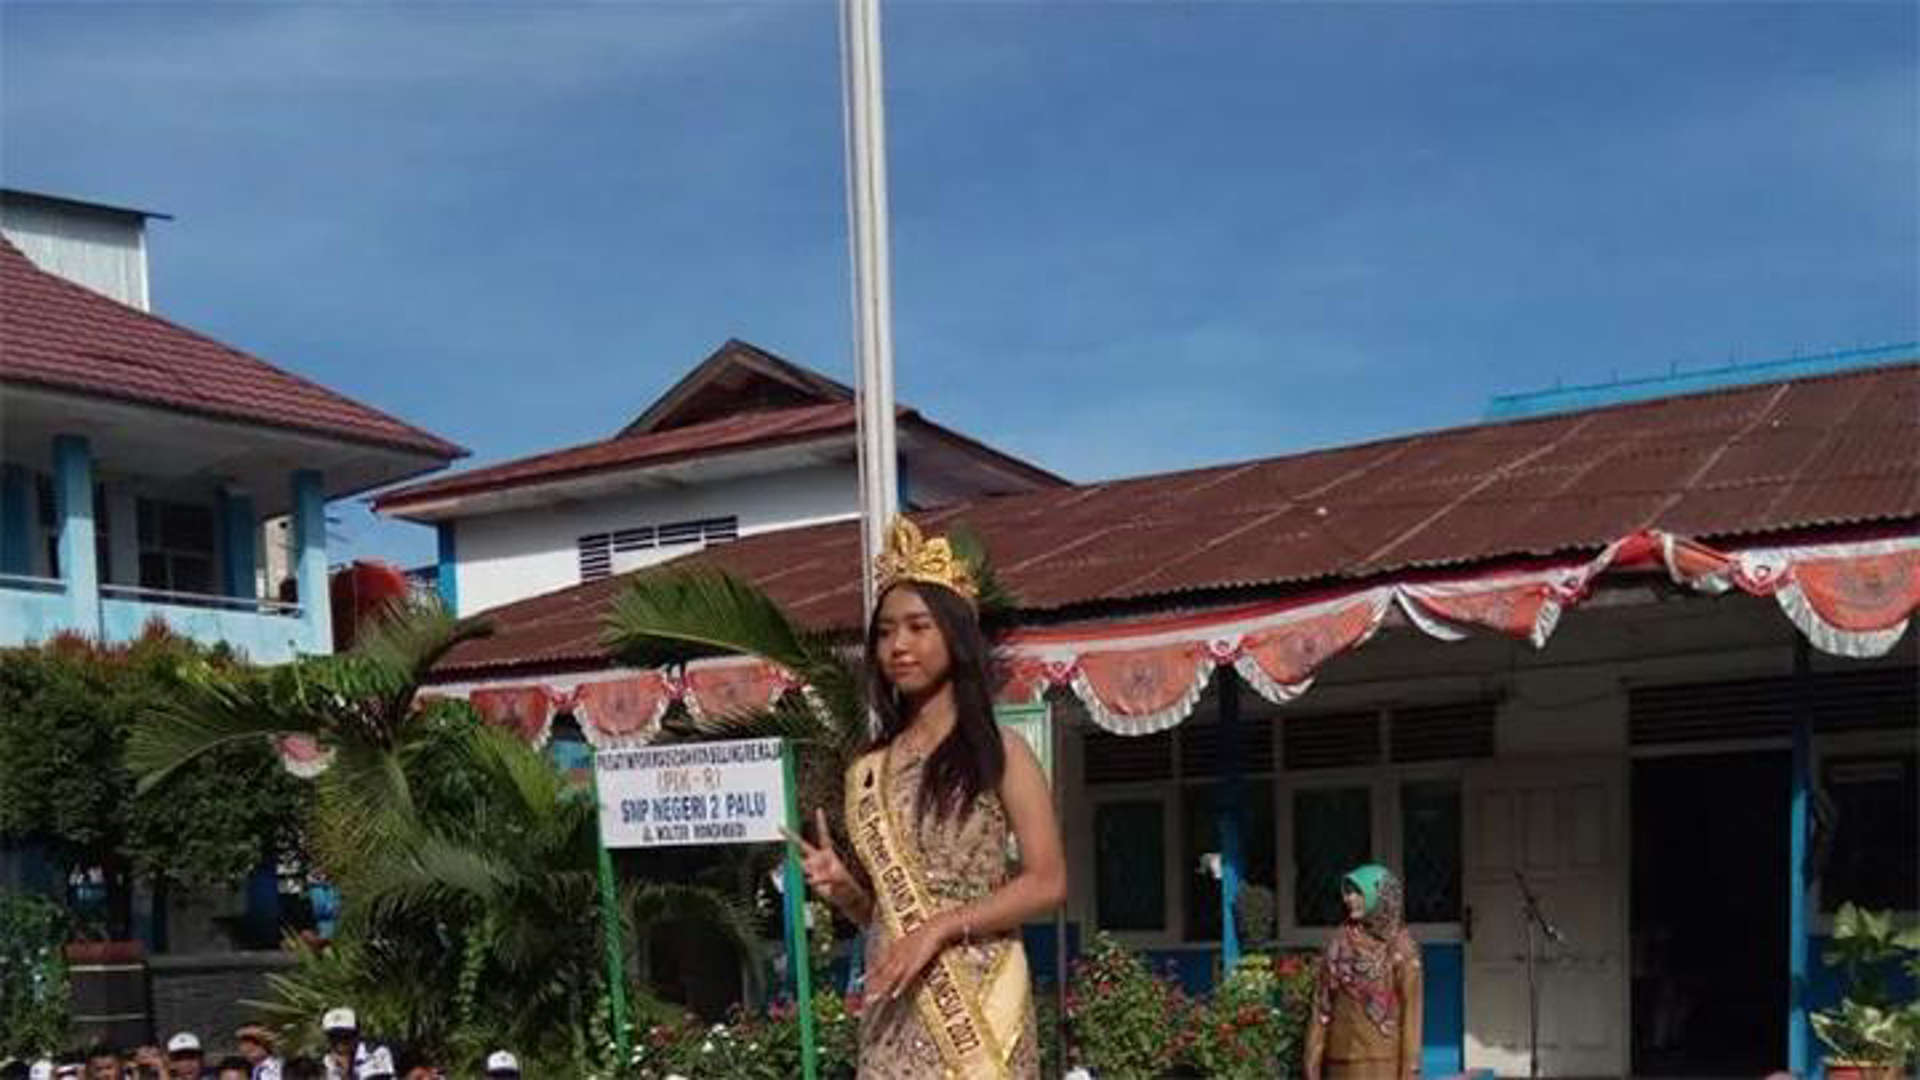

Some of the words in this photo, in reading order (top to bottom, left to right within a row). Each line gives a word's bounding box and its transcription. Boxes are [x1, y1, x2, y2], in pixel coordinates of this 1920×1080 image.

[620, 798, 649, 824] SMP
[653, 795, 707, 822] NEGERI
[709, 794, 720, 820] 2
[727, 791, 767, 818] PALU
